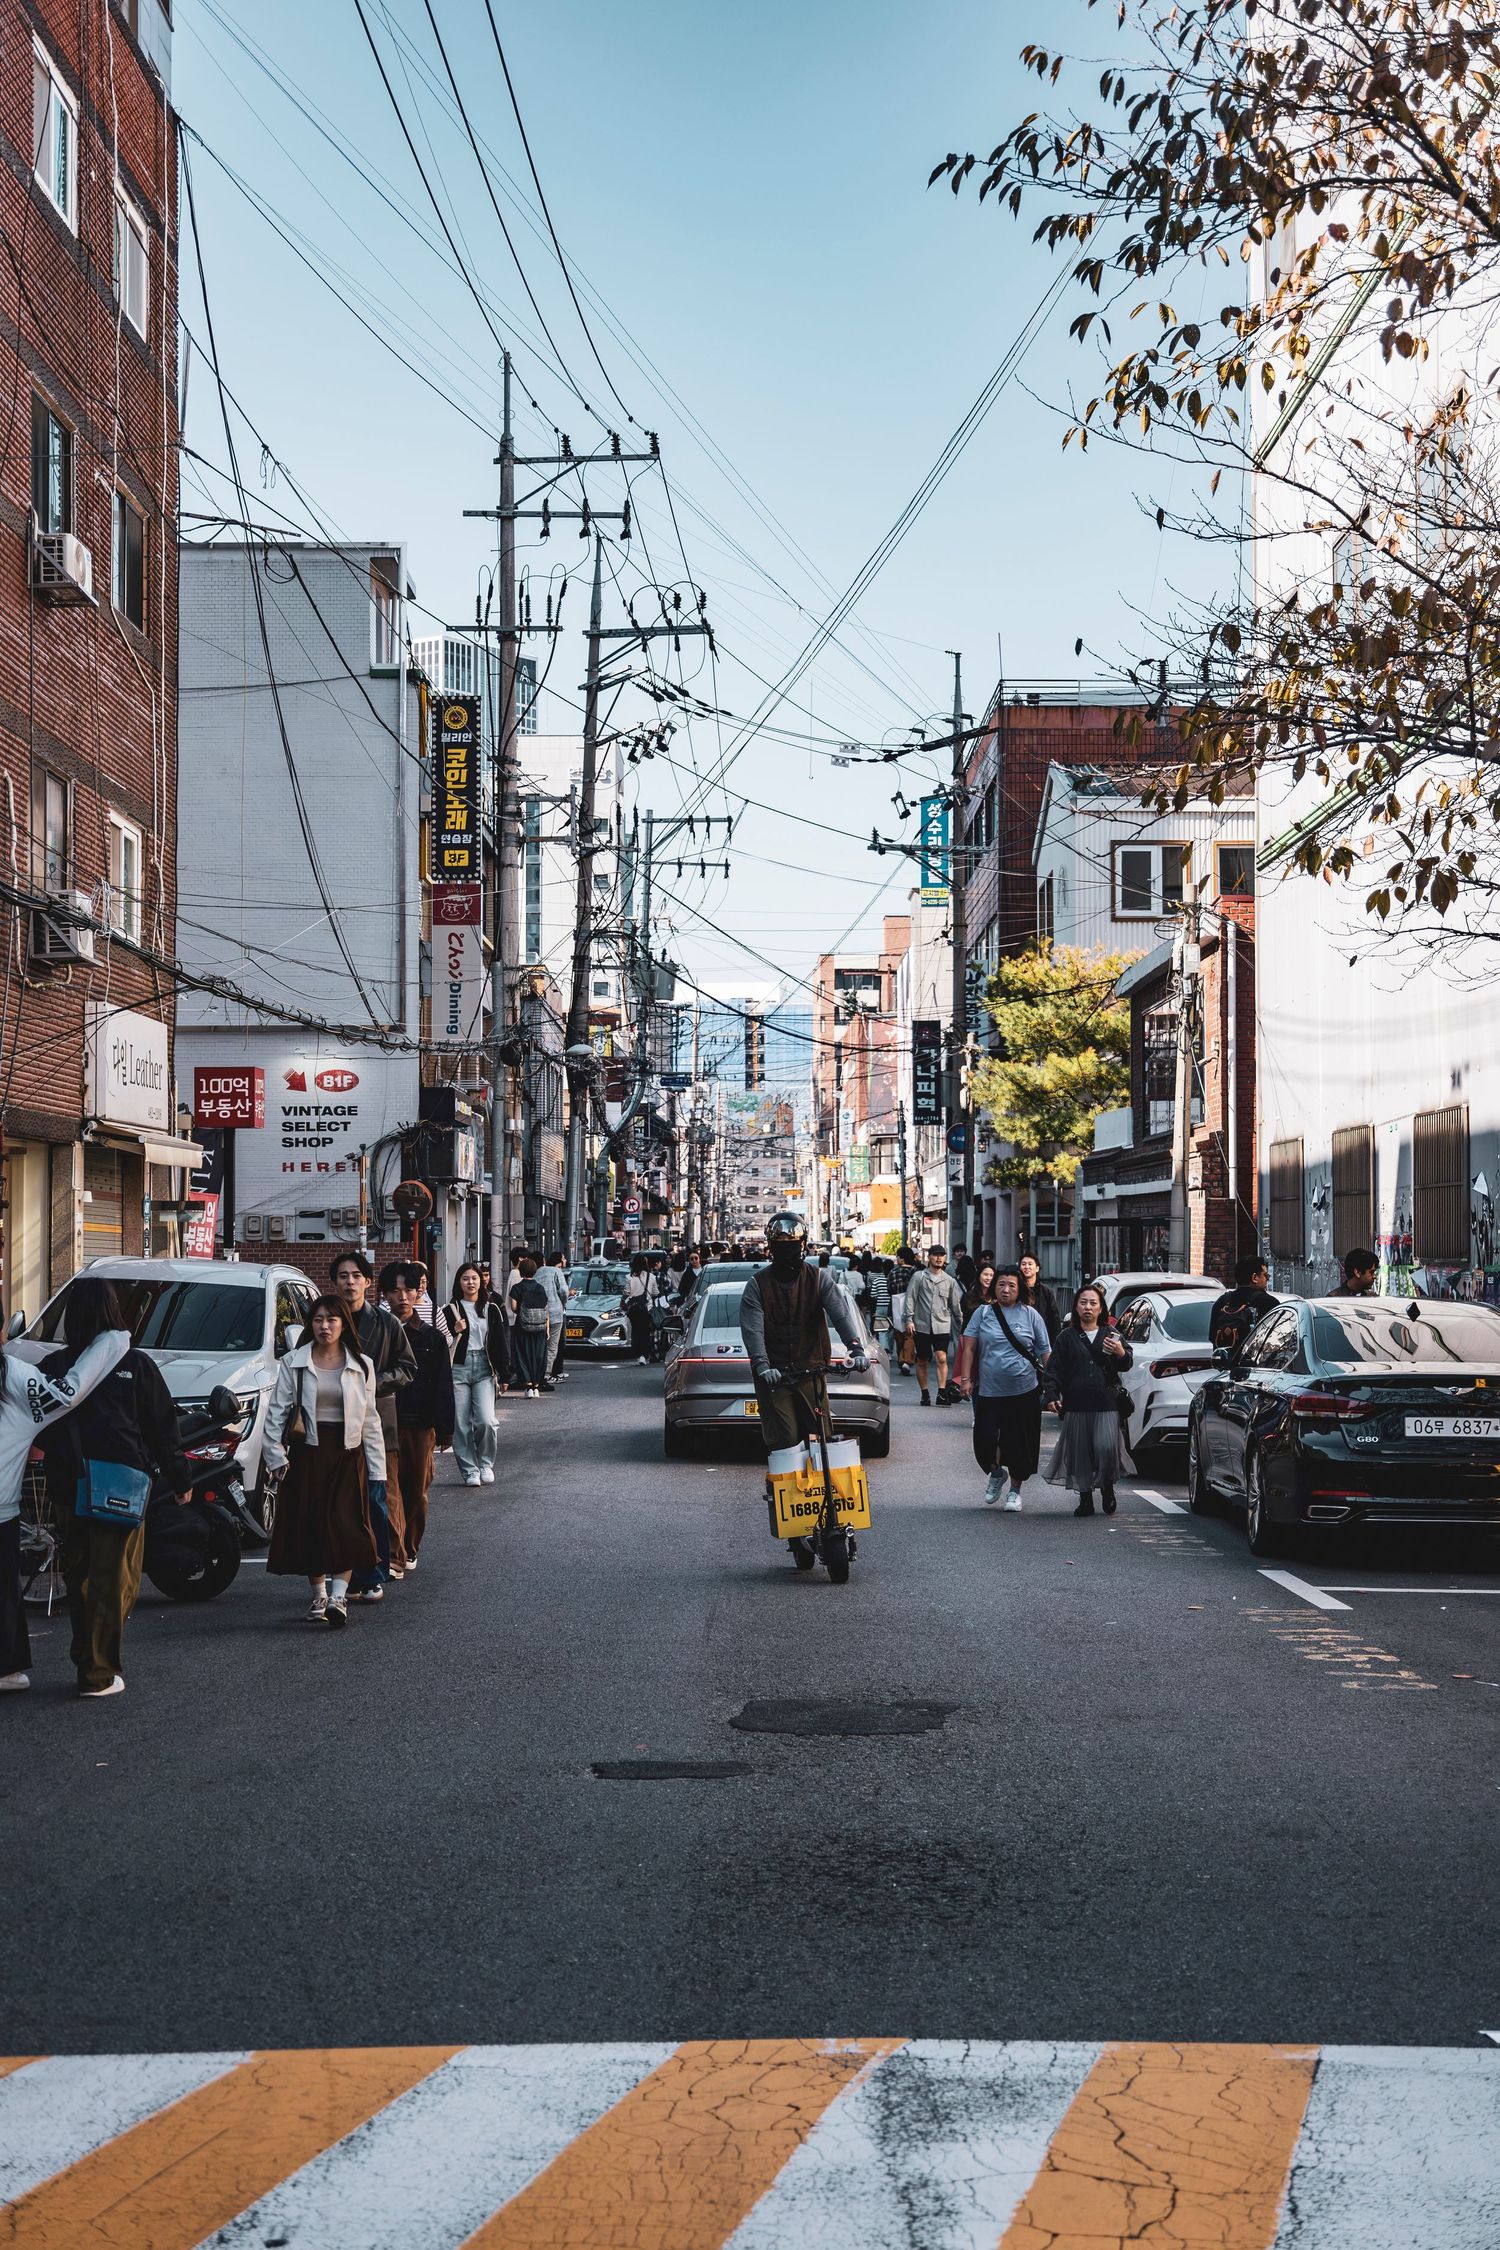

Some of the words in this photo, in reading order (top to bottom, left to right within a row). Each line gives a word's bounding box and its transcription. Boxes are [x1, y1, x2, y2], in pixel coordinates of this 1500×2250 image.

[441, 732, 473, 743] 밀리언
[445, 748, 468, 830] 코인노래
[440, 834, 473, 844] 연습장
[447, 853, 466, 864] 3F
[446, 981, 462, 1035] Dining
[130, 1044, 162, 1090] Leather
[199, 1077, 249, 1097] 100억
[323, 1075, 353, 1088] B1F
[198, 1098, 253, 1119] 부동산
[281, 1105, 358, 1116] VINTAGE
[281, 1121, 351, 1132] SELECT
[281, 1137, 334, 1148] SHOP
[184, 1225, 213, 1253] 부동산
[27, 1377, 44, 1424] adidas
[1413, 1419, 1445, 1434] 06무
[1452, 1420, 1492, 1435] 6837
